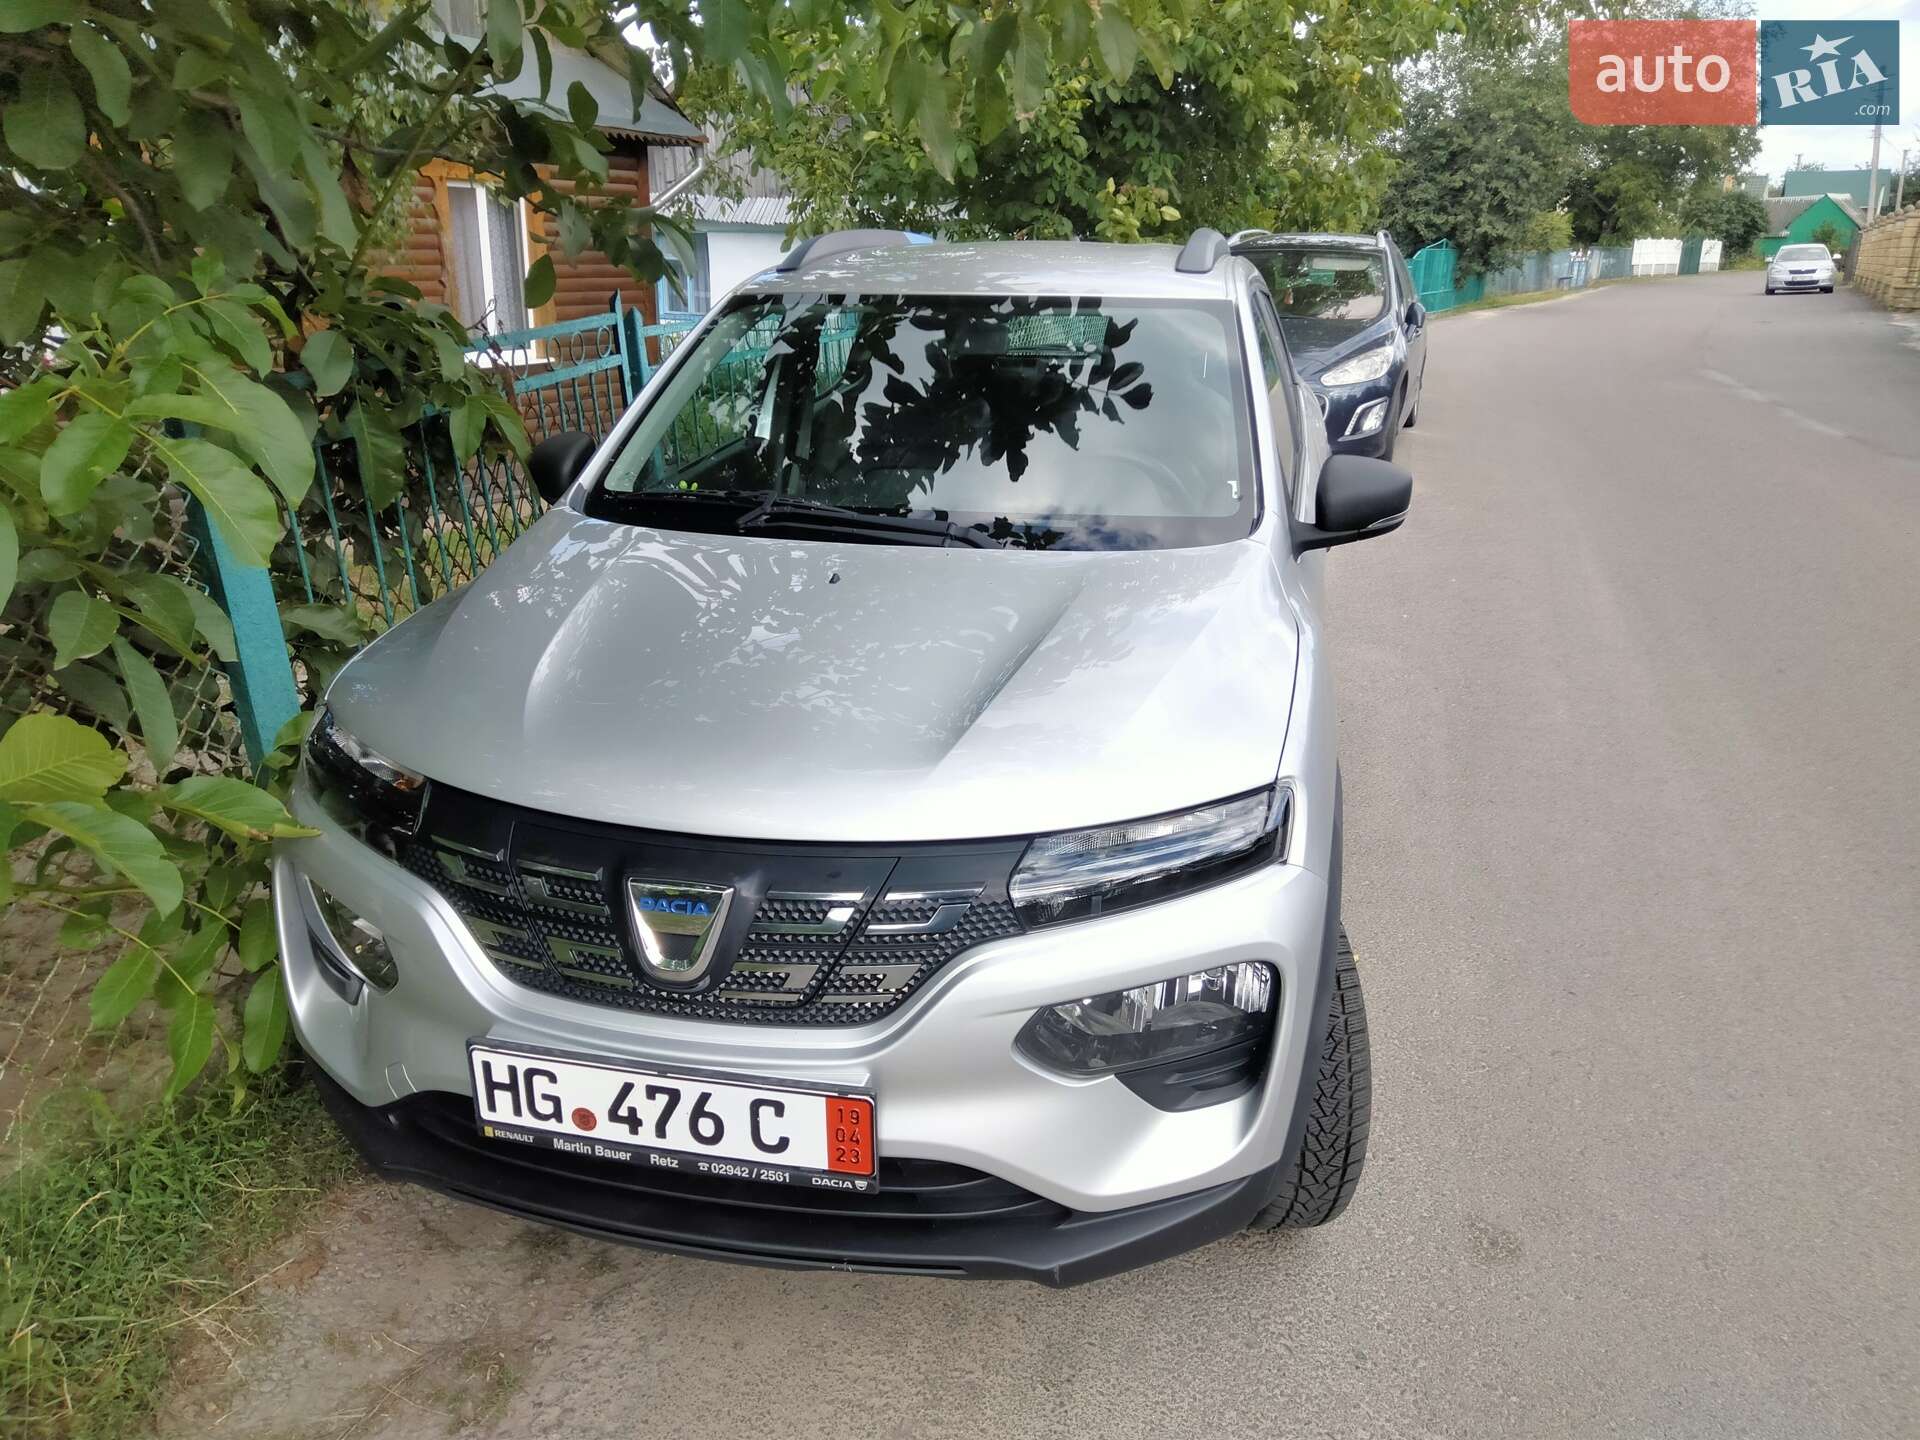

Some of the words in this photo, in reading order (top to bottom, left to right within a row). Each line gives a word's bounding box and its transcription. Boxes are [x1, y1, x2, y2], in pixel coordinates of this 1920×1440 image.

[639, 897, 712, 916] DACIA
[481, 1060, 563, 1124] HG
[607, 1082, 725, 1147] 476
[749, 1098, 791, 1154] C
[837, 1107, 860, 1125] 19
[494, 1129, 535, 1143] RENAULT
[835, 1127, 861, 1145] 04
[553, 1138, 592, 1155] Martin
[595, 1145, 632, 1161] Bauer
[650, 1154, 679, 1169] Retz
[711, 1163, 750, 1178] 02942
[835, 1147, 861, 1164] 23
[812, 1177, 853, 1189] DACIA
